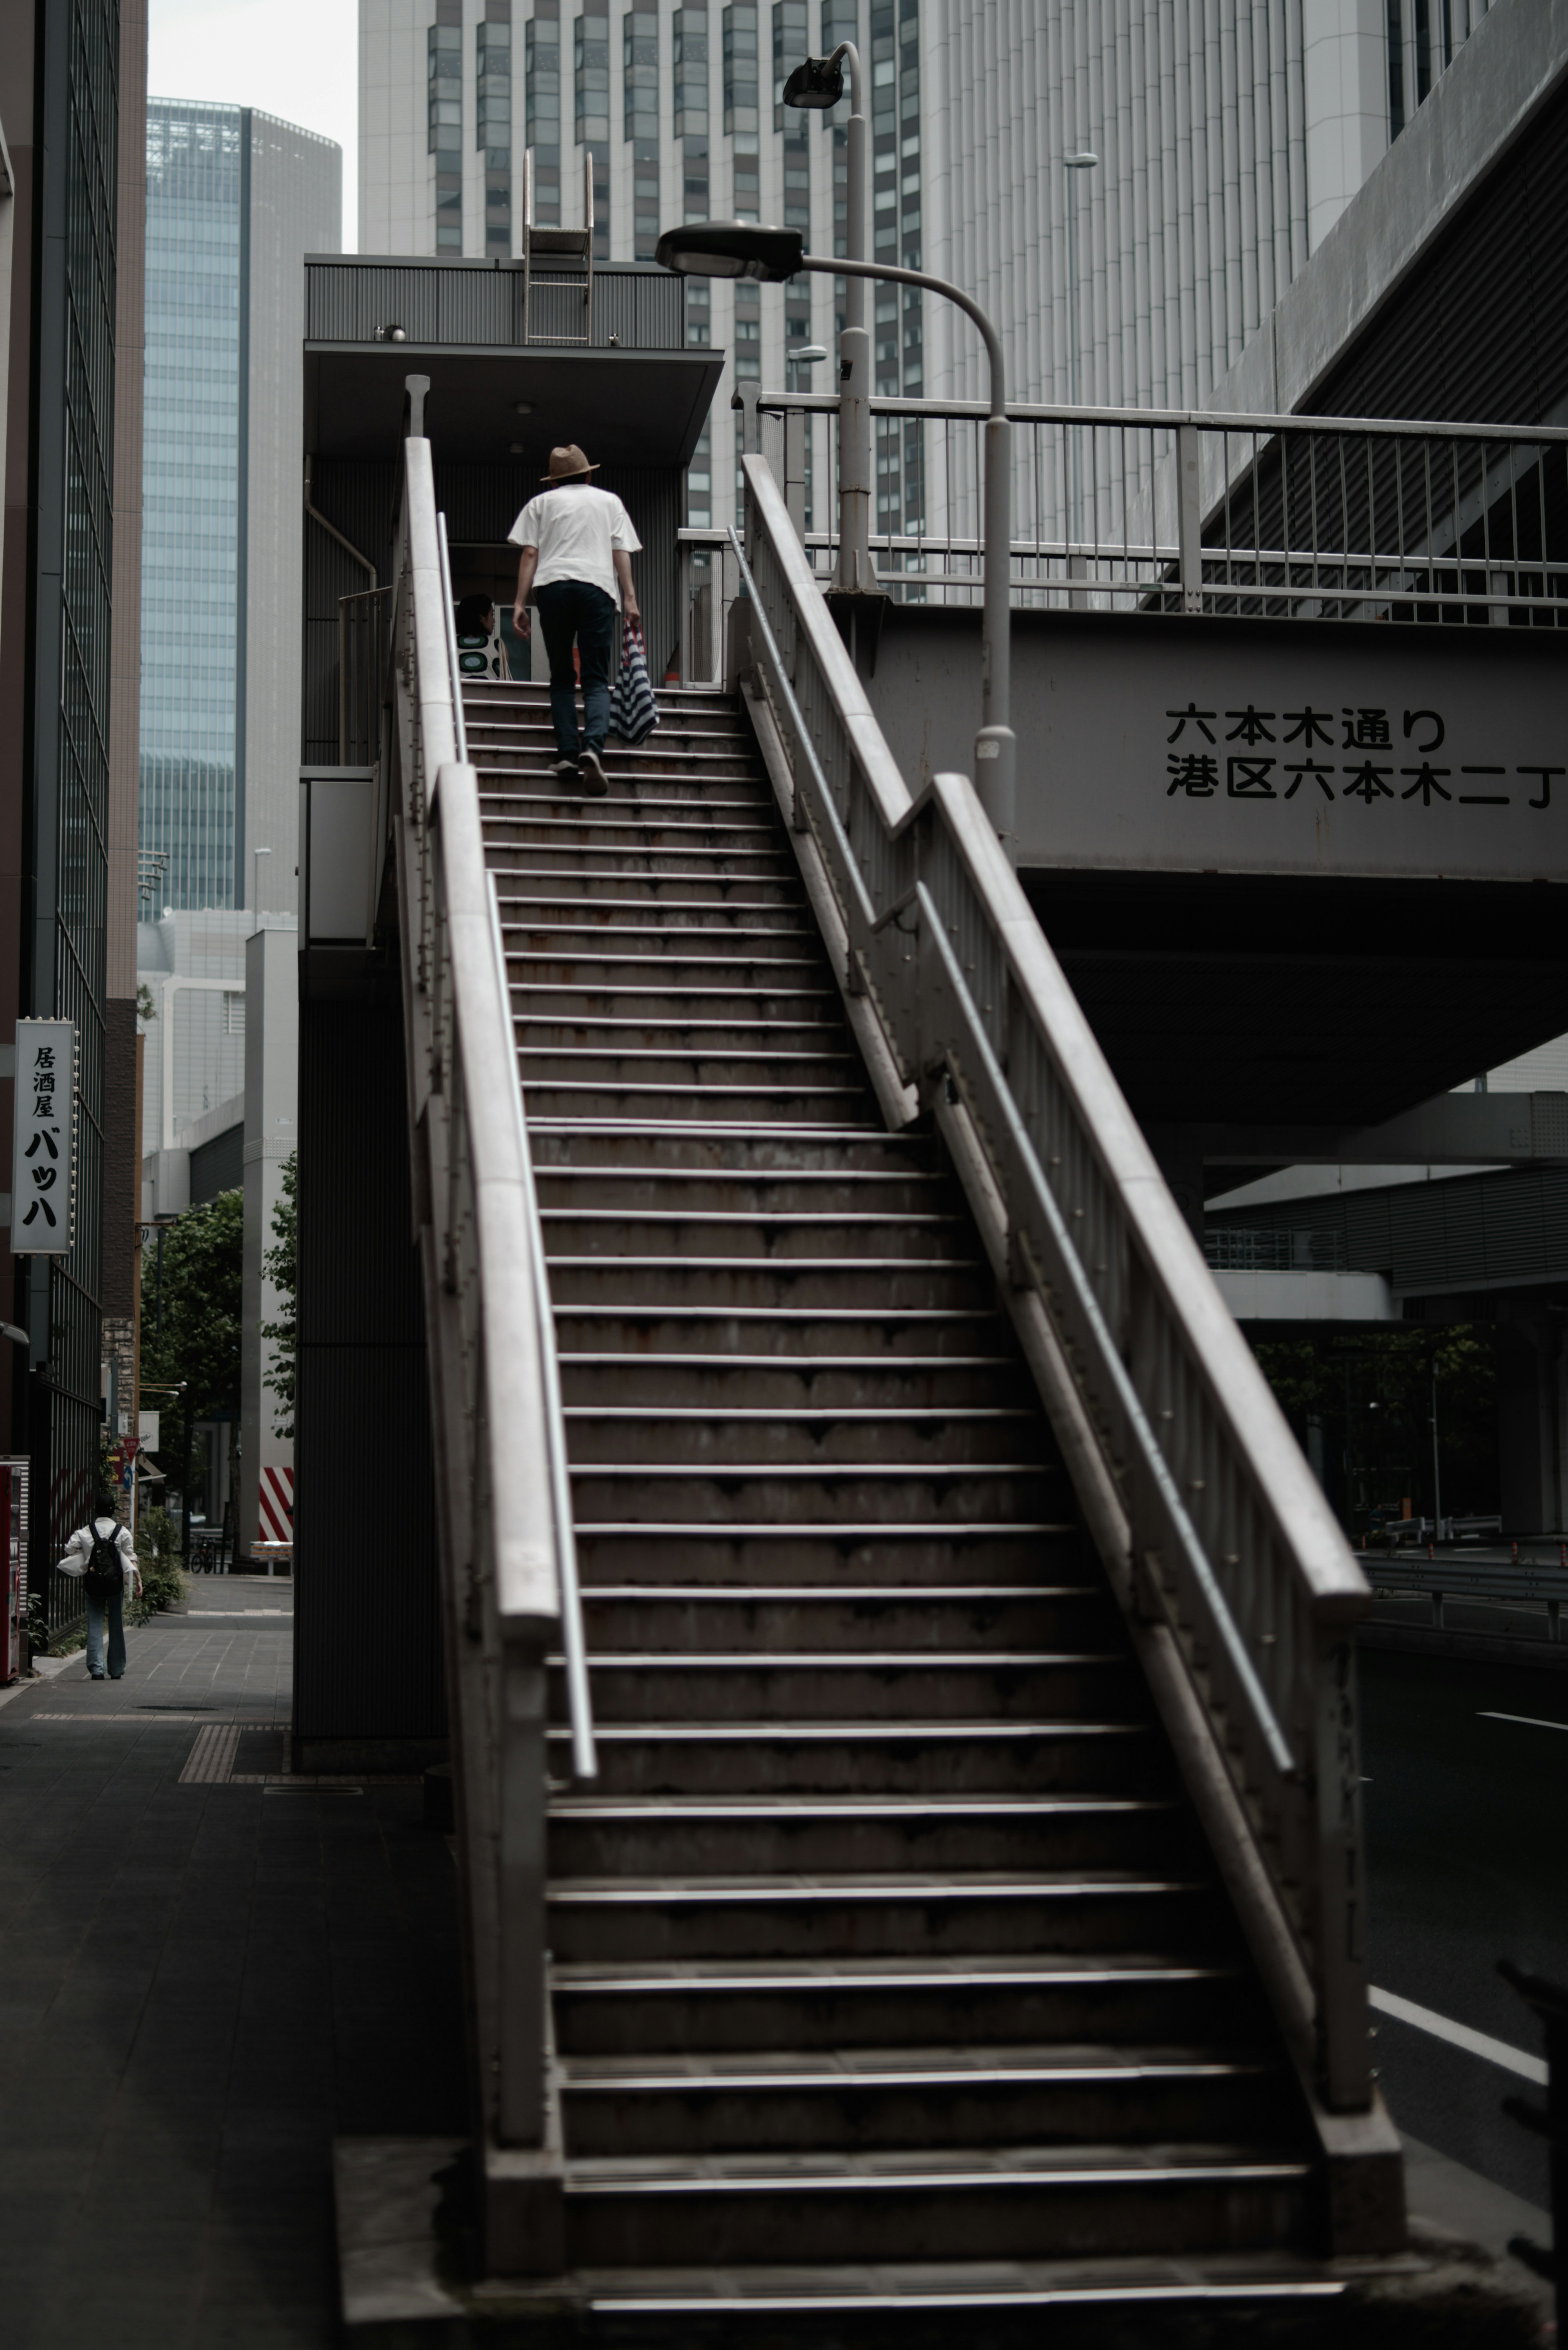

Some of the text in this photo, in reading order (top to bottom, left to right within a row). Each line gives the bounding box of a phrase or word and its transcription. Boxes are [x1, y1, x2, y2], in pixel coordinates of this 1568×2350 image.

[1165, 702, 1446, 752] 六本木通り
[1166, 753, 1566, 809] 港区六本木二丁
